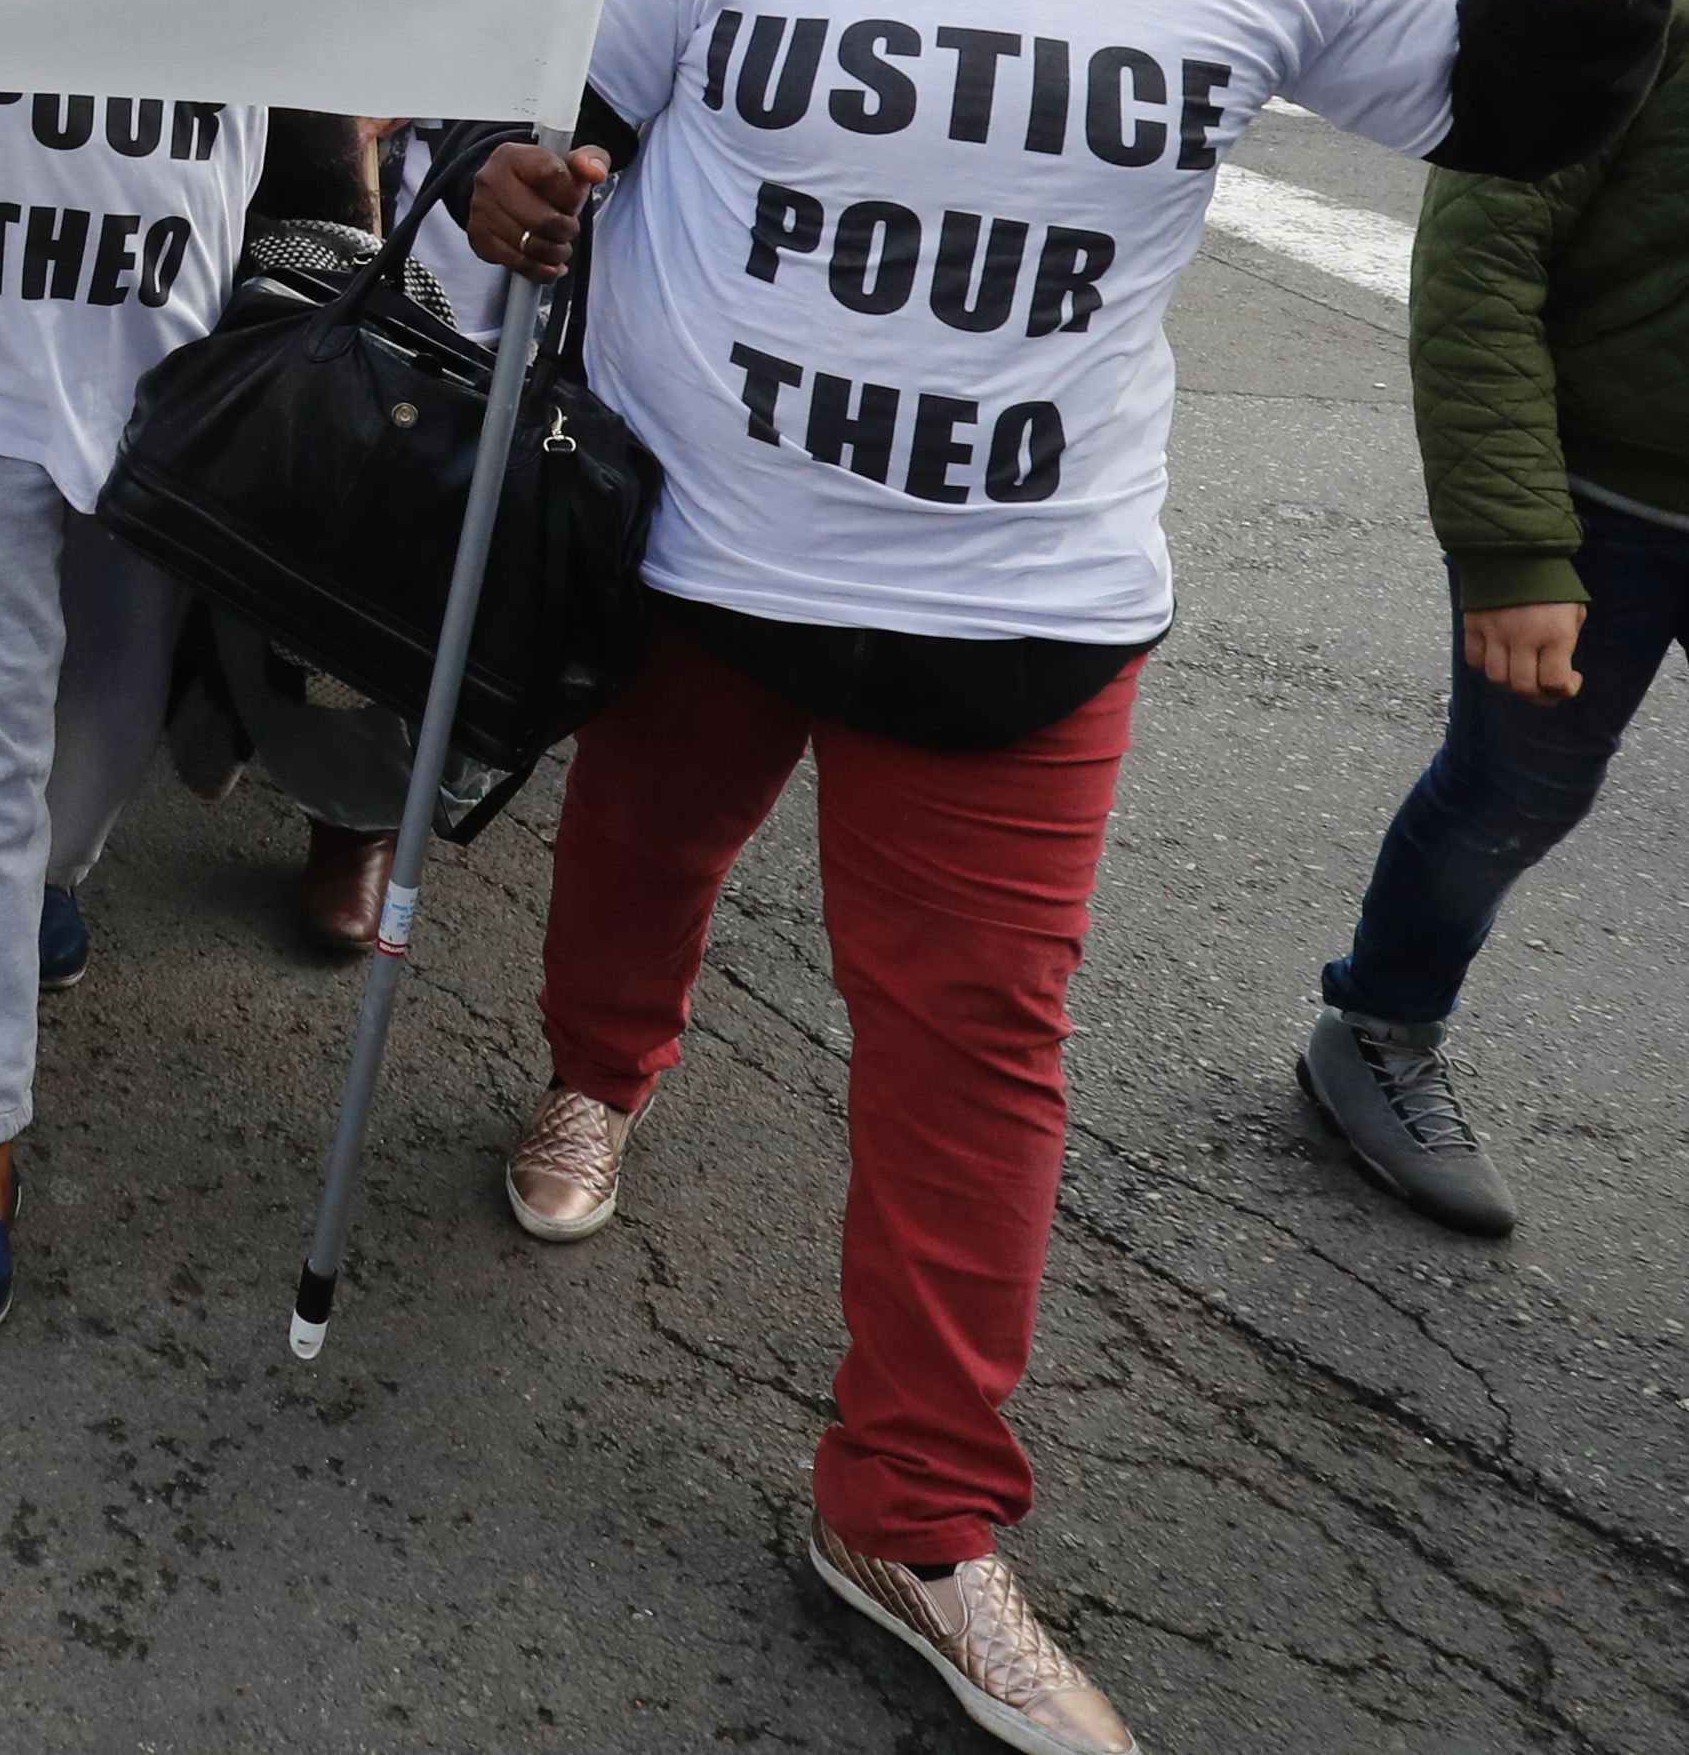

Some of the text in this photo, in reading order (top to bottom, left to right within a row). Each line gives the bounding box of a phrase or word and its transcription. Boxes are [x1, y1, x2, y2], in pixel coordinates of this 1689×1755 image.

[703, 9, 1231, 171] JUSTICE
[745, 181, 1116, 338] POUR
[729, 341, 1066, 505] THEO
